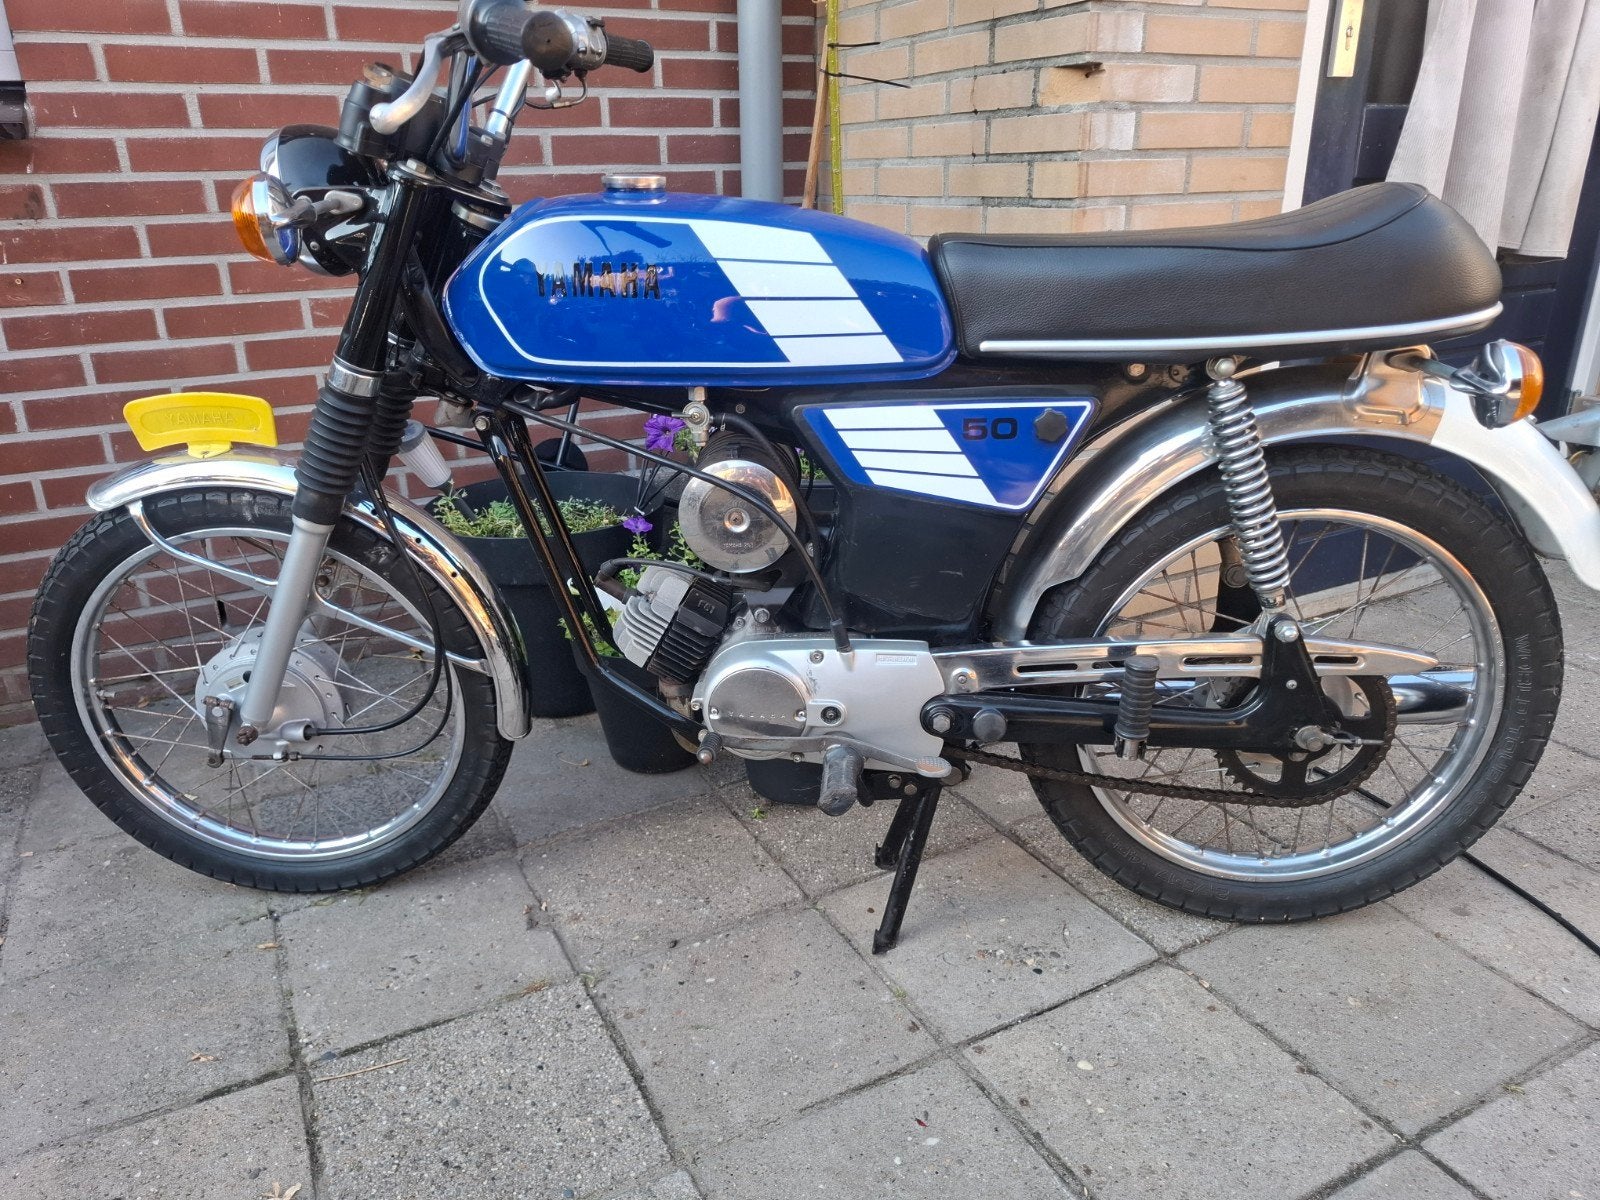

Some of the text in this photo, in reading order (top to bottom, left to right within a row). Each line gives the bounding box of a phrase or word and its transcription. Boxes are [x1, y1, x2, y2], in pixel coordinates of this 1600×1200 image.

[536, 262, 661, 299] YAMAHA
[165, 409, 236, 425] YAMAHA
[963, 417, 1018, 440] 50
